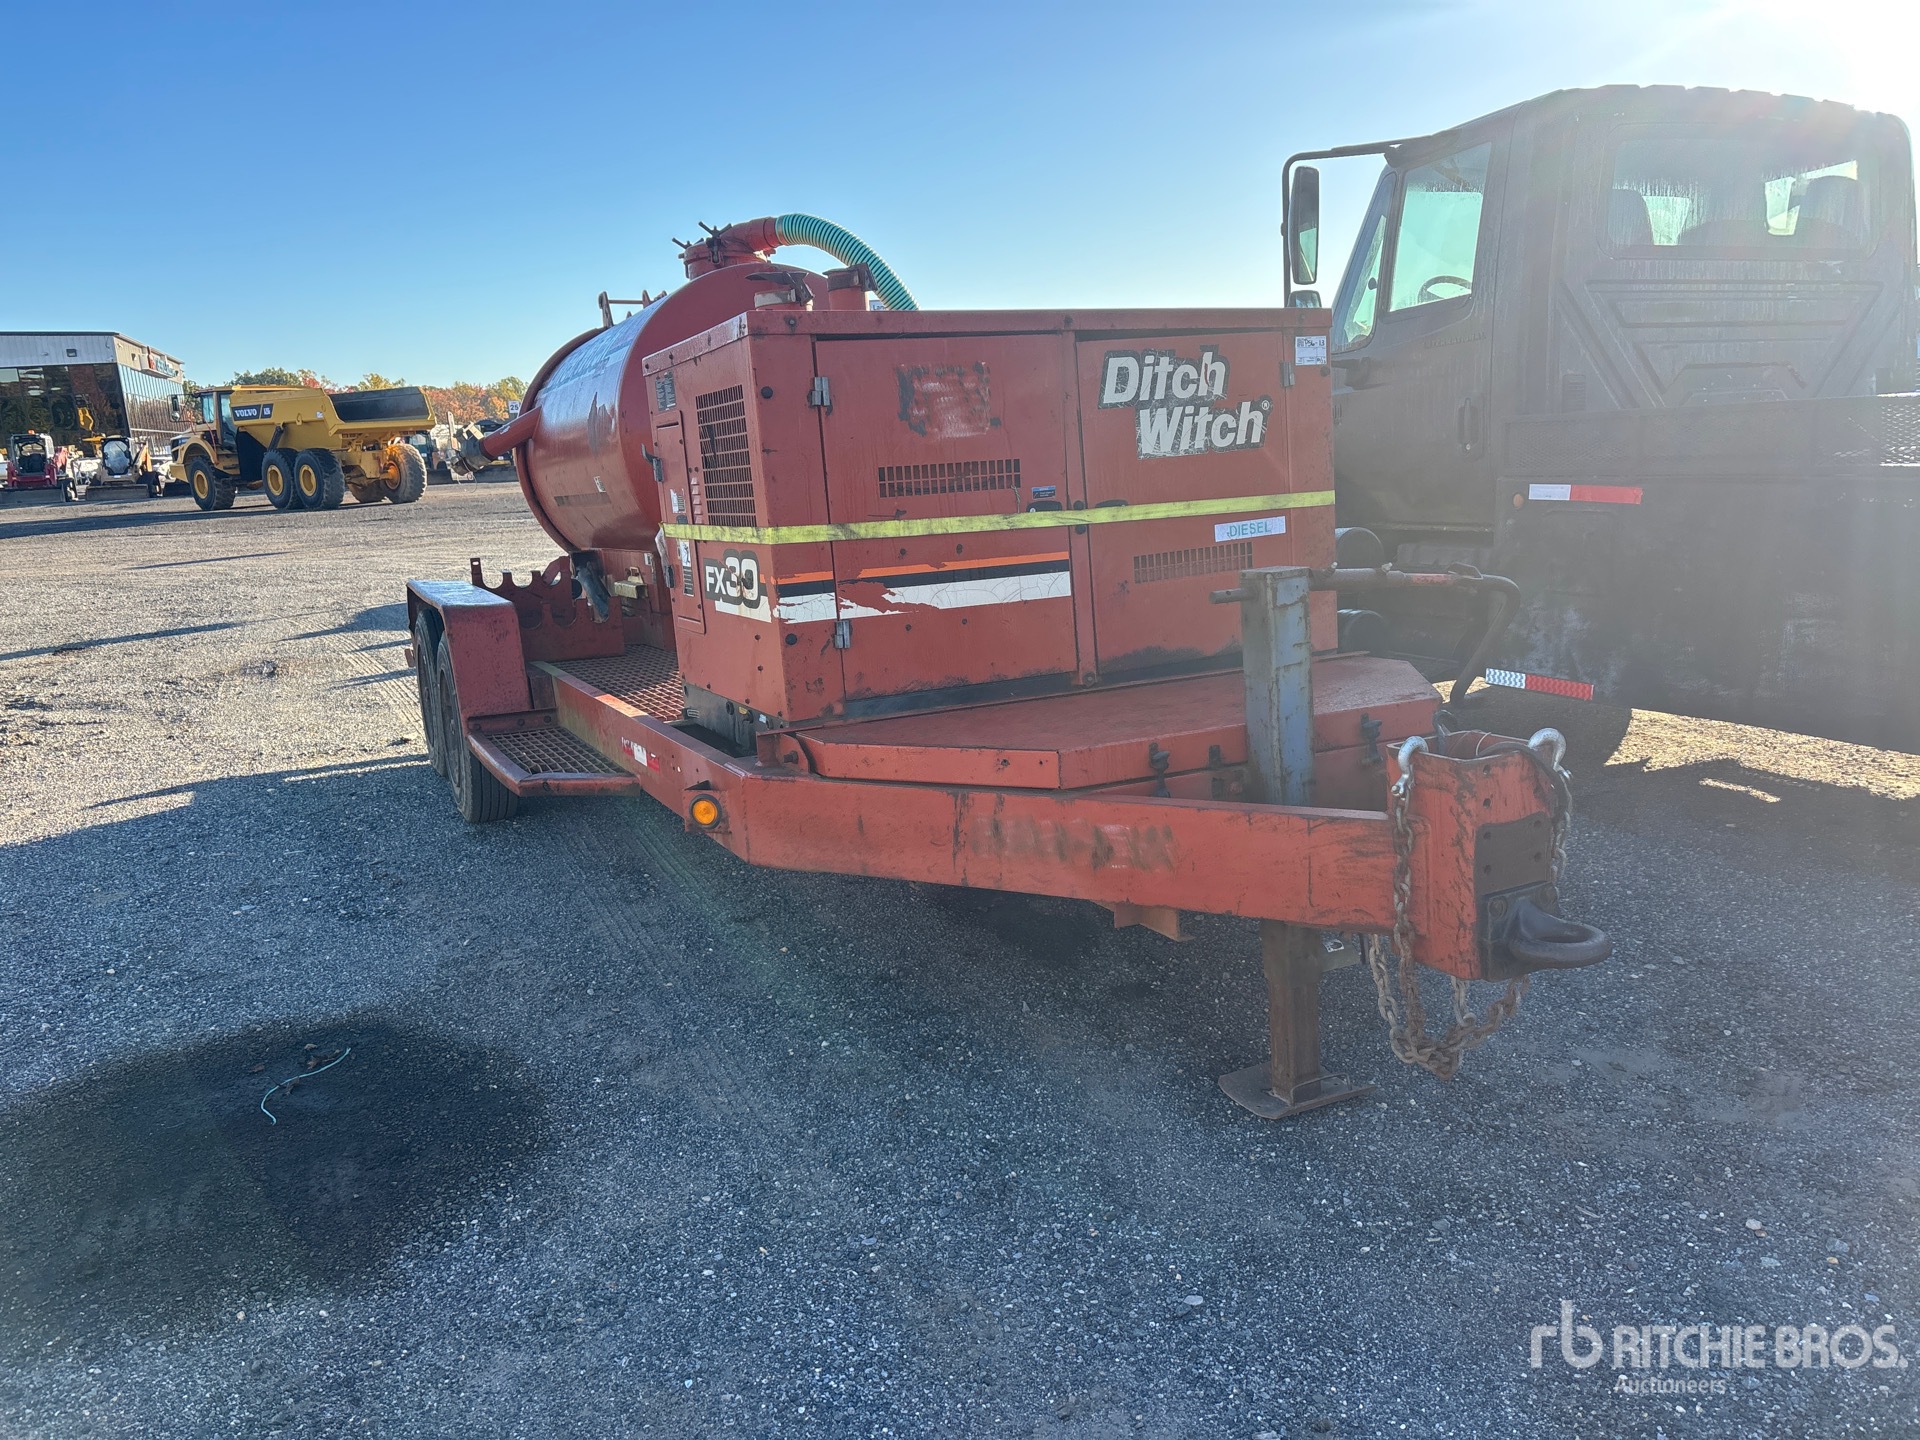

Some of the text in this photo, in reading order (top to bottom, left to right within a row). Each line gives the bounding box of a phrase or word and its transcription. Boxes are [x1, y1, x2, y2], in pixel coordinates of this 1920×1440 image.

[1103, 352, 1226, 404] Ditch
[235, 408, 257, 418] VOLVO
[1139, 401, 1264, 455] Witch
[1229, 521, 1271, 537] DIESEL
[705, 556, 759, 601] FX30
